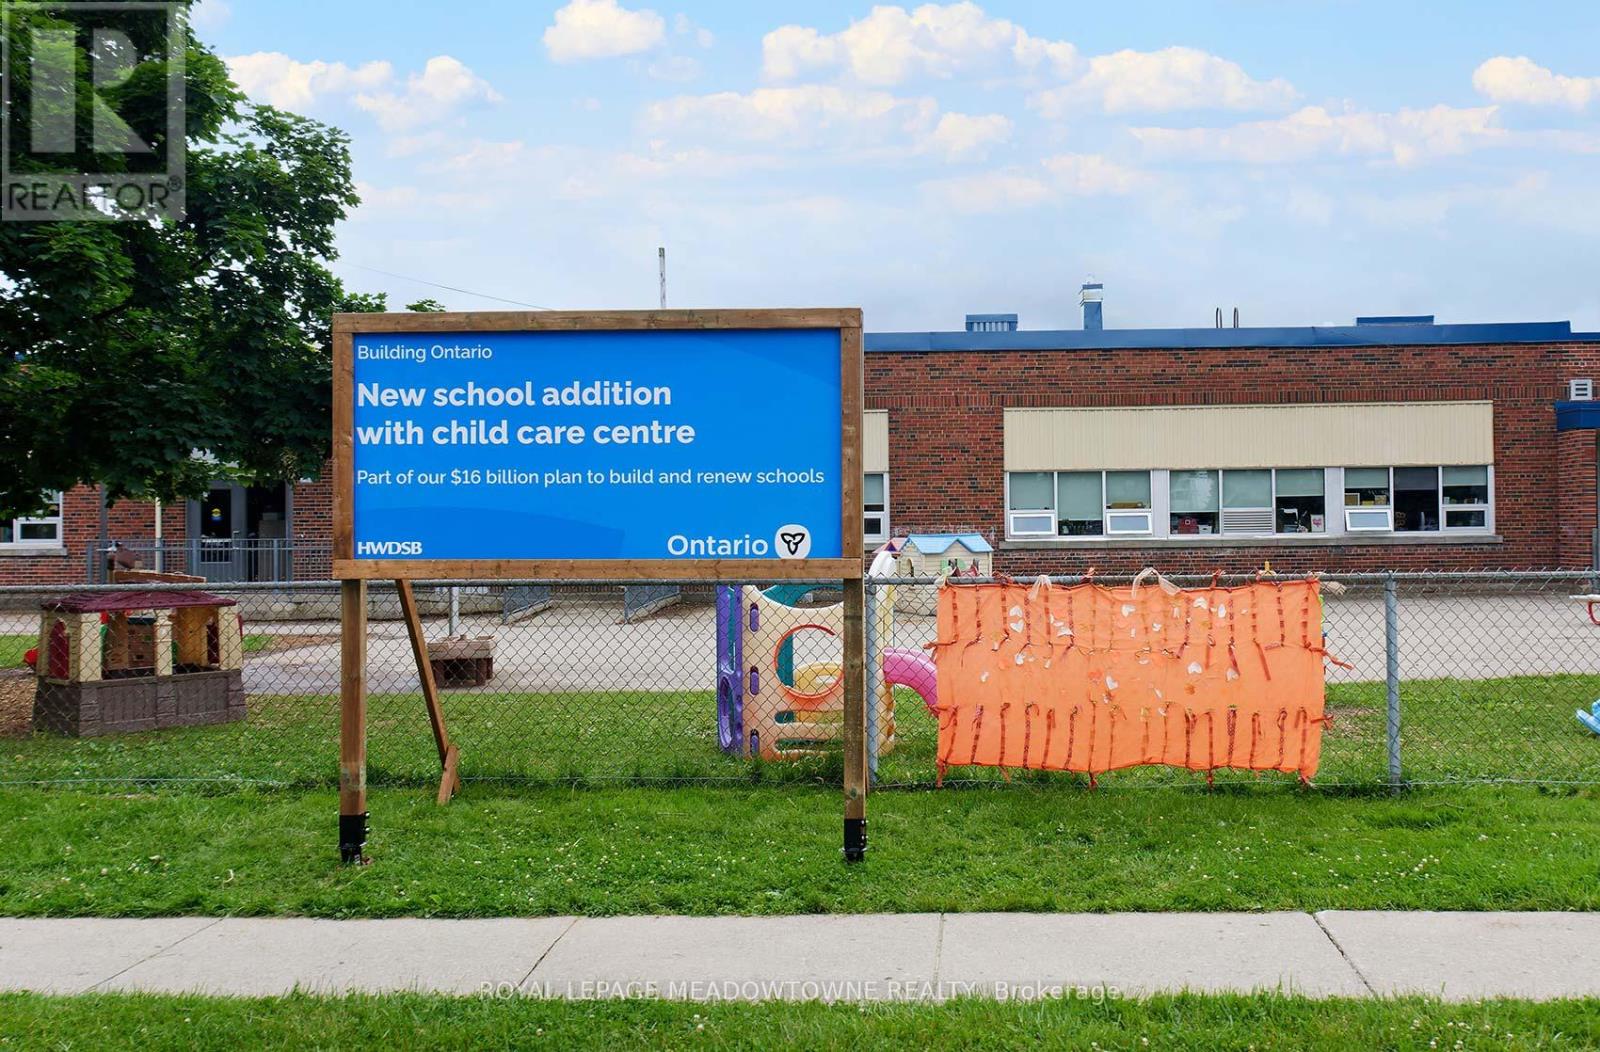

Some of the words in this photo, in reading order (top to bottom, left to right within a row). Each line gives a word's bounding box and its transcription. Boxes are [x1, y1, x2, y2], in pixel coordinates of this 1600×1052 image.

[357, 344, 427, 363] Building
[430, 344, 493, 360] Ontario
[357, 382, 427, 407] New
[432, 381, 536, 407] school
[542, 380, 672, 406] addition
[356, 420, 424, 445] with
[432, 419, 509, 445] child
[516, 425, 586, 445] care
[593, 420, 696, 445] centre
[357, 470, 392, 485] Part
[395, 469, 414, 485] of
[417, 473, 447, 485] our
[450, 468, 481, 486] $16
[486, 469, 539, 485] billion
[544, 469, 582, 488] plan
[587, 470, 605, 484] to
[609, 469, 654, 484] build
[658, 468, 692, 484] and
[697, 472, 752, 484] renew
[756, 468, 825, 484] schools
[357, 541, 423, 555] HWDSB
[666, 534, 769, 556] Ontario
